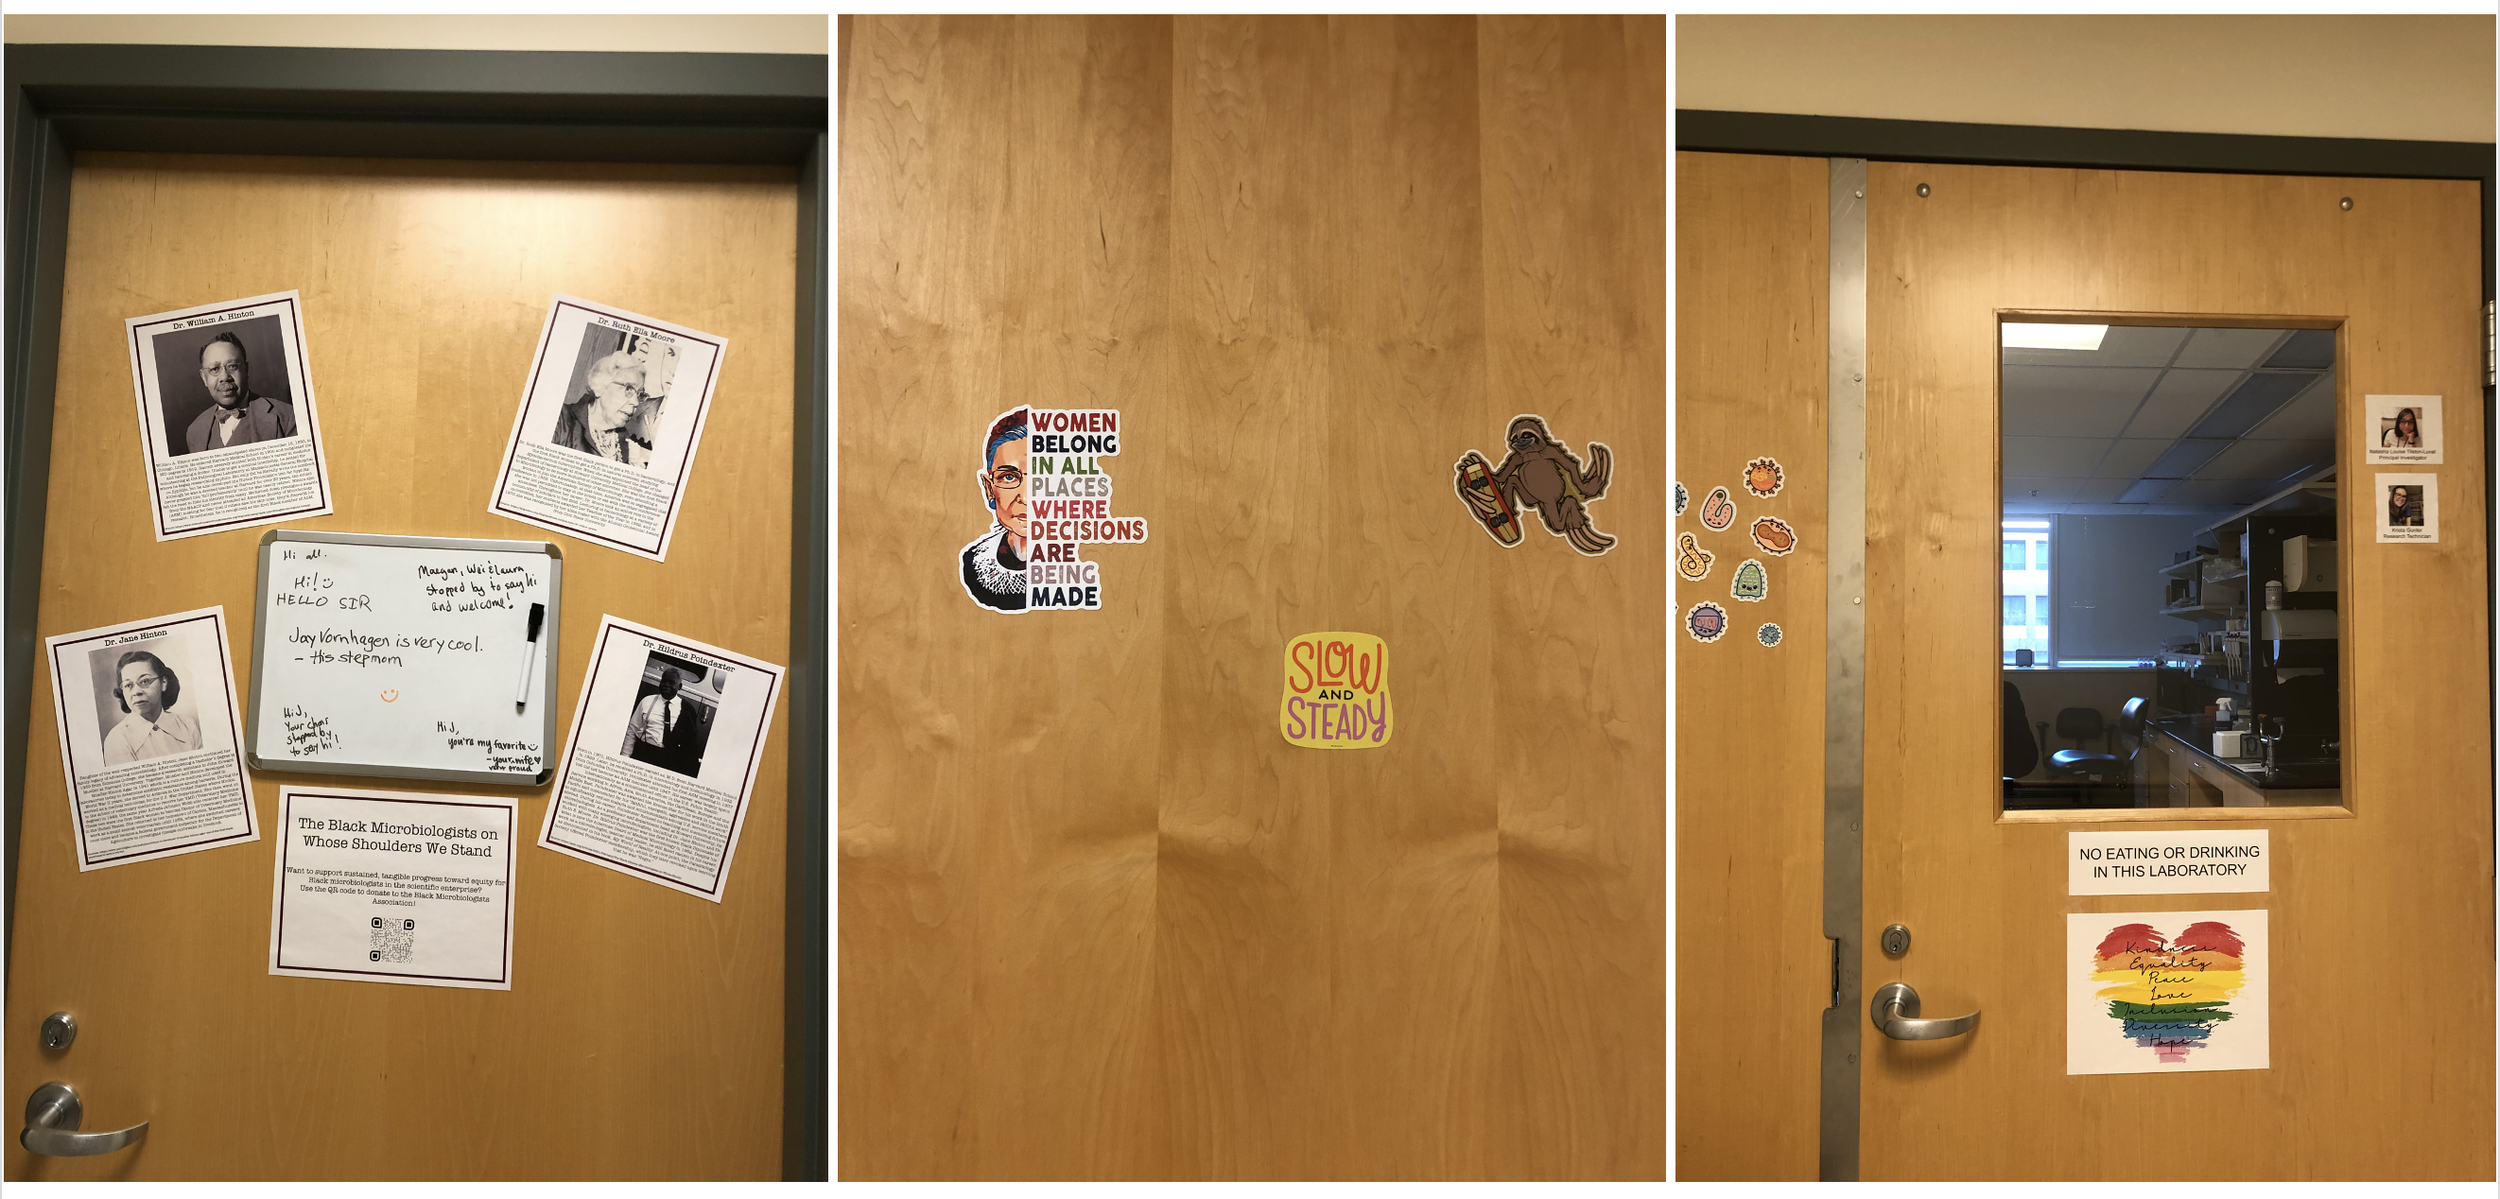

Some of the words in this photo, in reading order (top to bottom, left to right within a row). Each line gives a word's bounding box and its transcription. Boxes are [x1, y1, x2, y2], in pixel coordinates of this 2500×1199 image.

[173, 322, 186, 330] Dr.
[186, 317, 216, 328] William
[217, 315, 227, 323] A.
[228, 310, 255, 321] Hinton
[598, 317, 610, 326] Dr.
[612, 321, 631, 332] Ruth
[633, 326, 649, 337] Ella
[650, 331, 676, 344] Moore
[1031, 412, 1116, 432] WOMEN
[1032, 435, 1117, 453] BELONG
[1032, 456, 1054, 475] IN
[1060, 456, 1099, 475] ALL
[1032, 477, 1109, 497] PLACES
[1031, 500, 1107, 519] WHERE
[1031, 520, 1144, 541] DECISIONS
[283, 549, 296, 561] Hi
[1030, 543, 1075, 563] ARE
[294, 571, 318, 592] Hi!
[1031, 564, 1096, 584] BEING
[426, 582, 465, 597] stopped
[471, 581, 486, 597] by
[490, 581, 502, 591] to
[504, 581, 525, 594] say
[526, 573, 538, 587] hi
[276, 592, 329, 607] HELLO
[338, 594, 373, 613] SIR
[431, 600, 452, 612] and
[458, 592, 514, 613] welcome!
[1031, 587, 1098, 607] MADE
[104, 638, 118, 647] Dr.
[119, 634, 139, 645] Jane
[140, 629, 168, 640] Hinton
[288, 626, 316, 648] Jay
[319, 627, 390, 653] Vornhagen
[396, 633, 411, 648] is
[414, 636, 445, 654] very
[447, 635, 483, 653] cool.
[309, 649, 335, 665] His
[337, 650, 403, 668] stepmom
[643, 640, 655, 650] Dr.
[657, 644, 689, 660] Hildrus
[690, 653, 736, 673] Poindexter
[1289, 640, 1382, 695] SLOW
[1318, 689, 1354, 700] AND
[283, 707, 294, 718] Hi
[295, 704, 308, 718] J,
[1287, 691, 1387, 743] STEADY
[319, 726, 332, 740] by
[437, 721, 447, 732] Hi
[449, 721, 460, 735] J,
[290, 746, 301, 757] to
[303, 743, 319, 756] say
[447, 738, 475, 750] you're
[477, 740, 492, 754] my
[494, 739, 527, 751] favorite
[508, 764, 533, 772] proud
[298, 818, 324, 830] The
[328, 819, 367, 833] Black
[370, 821, 477, 840] Microbiologists
[480, 830, 498, 841] on
[303, 835, 348, 849] Whose
[351, 838, 422, 854] Shoulders
[426, 842, 447, 854] We
[451, 843, 492, 858] Stand
[2080, 848, 2102, 861] NO
[2106, 847, 2160, 860] EATING
[2163, 846, 2185, 859] OR
[2190, 845, 2260, 859] DRINKING
[286, 867, 305, 875] Want
[315, 869, 342, 878] support
[344, 870, 380, 879] sustained,
[382, 873, 410, 882] tangible
[412, 875, 443, 883] progress
[444, 876, 469, 884] toward
[471, 877, 493, 887] equity
[2093, 866, 2108, 878] IN
[2112, 865, 2145, 878] THIS
[2149, 863, 2248, 877] LABORATORY
[309, 876, 329, 884] Black
[330, 877, 383, 888] microbiologists
[407, 881, 439, 891] scientific
[440, 883, 483, 894] enterprise?
[328, 886, 338, 895] QR
[340, 887, 356, 895] code
[366, 889, 390, 897] donate
[414, 891, 434, 900] Black
[436, 893, 489, 903] Microbiologists
[372, 897, 416, 907] Association!
[2125, 941, 2217, 955] Kindness
[2129, 957, 2213, 975] Equality
[2148, 971, 2194, 985] Peace
[2150, 986, 2193, 1001] Love
[2124, 1003, 2219, 1017] Inclusion
[2122, 1019, 2220, 1033] Diversity
[2149, 1033, 2194, 1053] Hope
